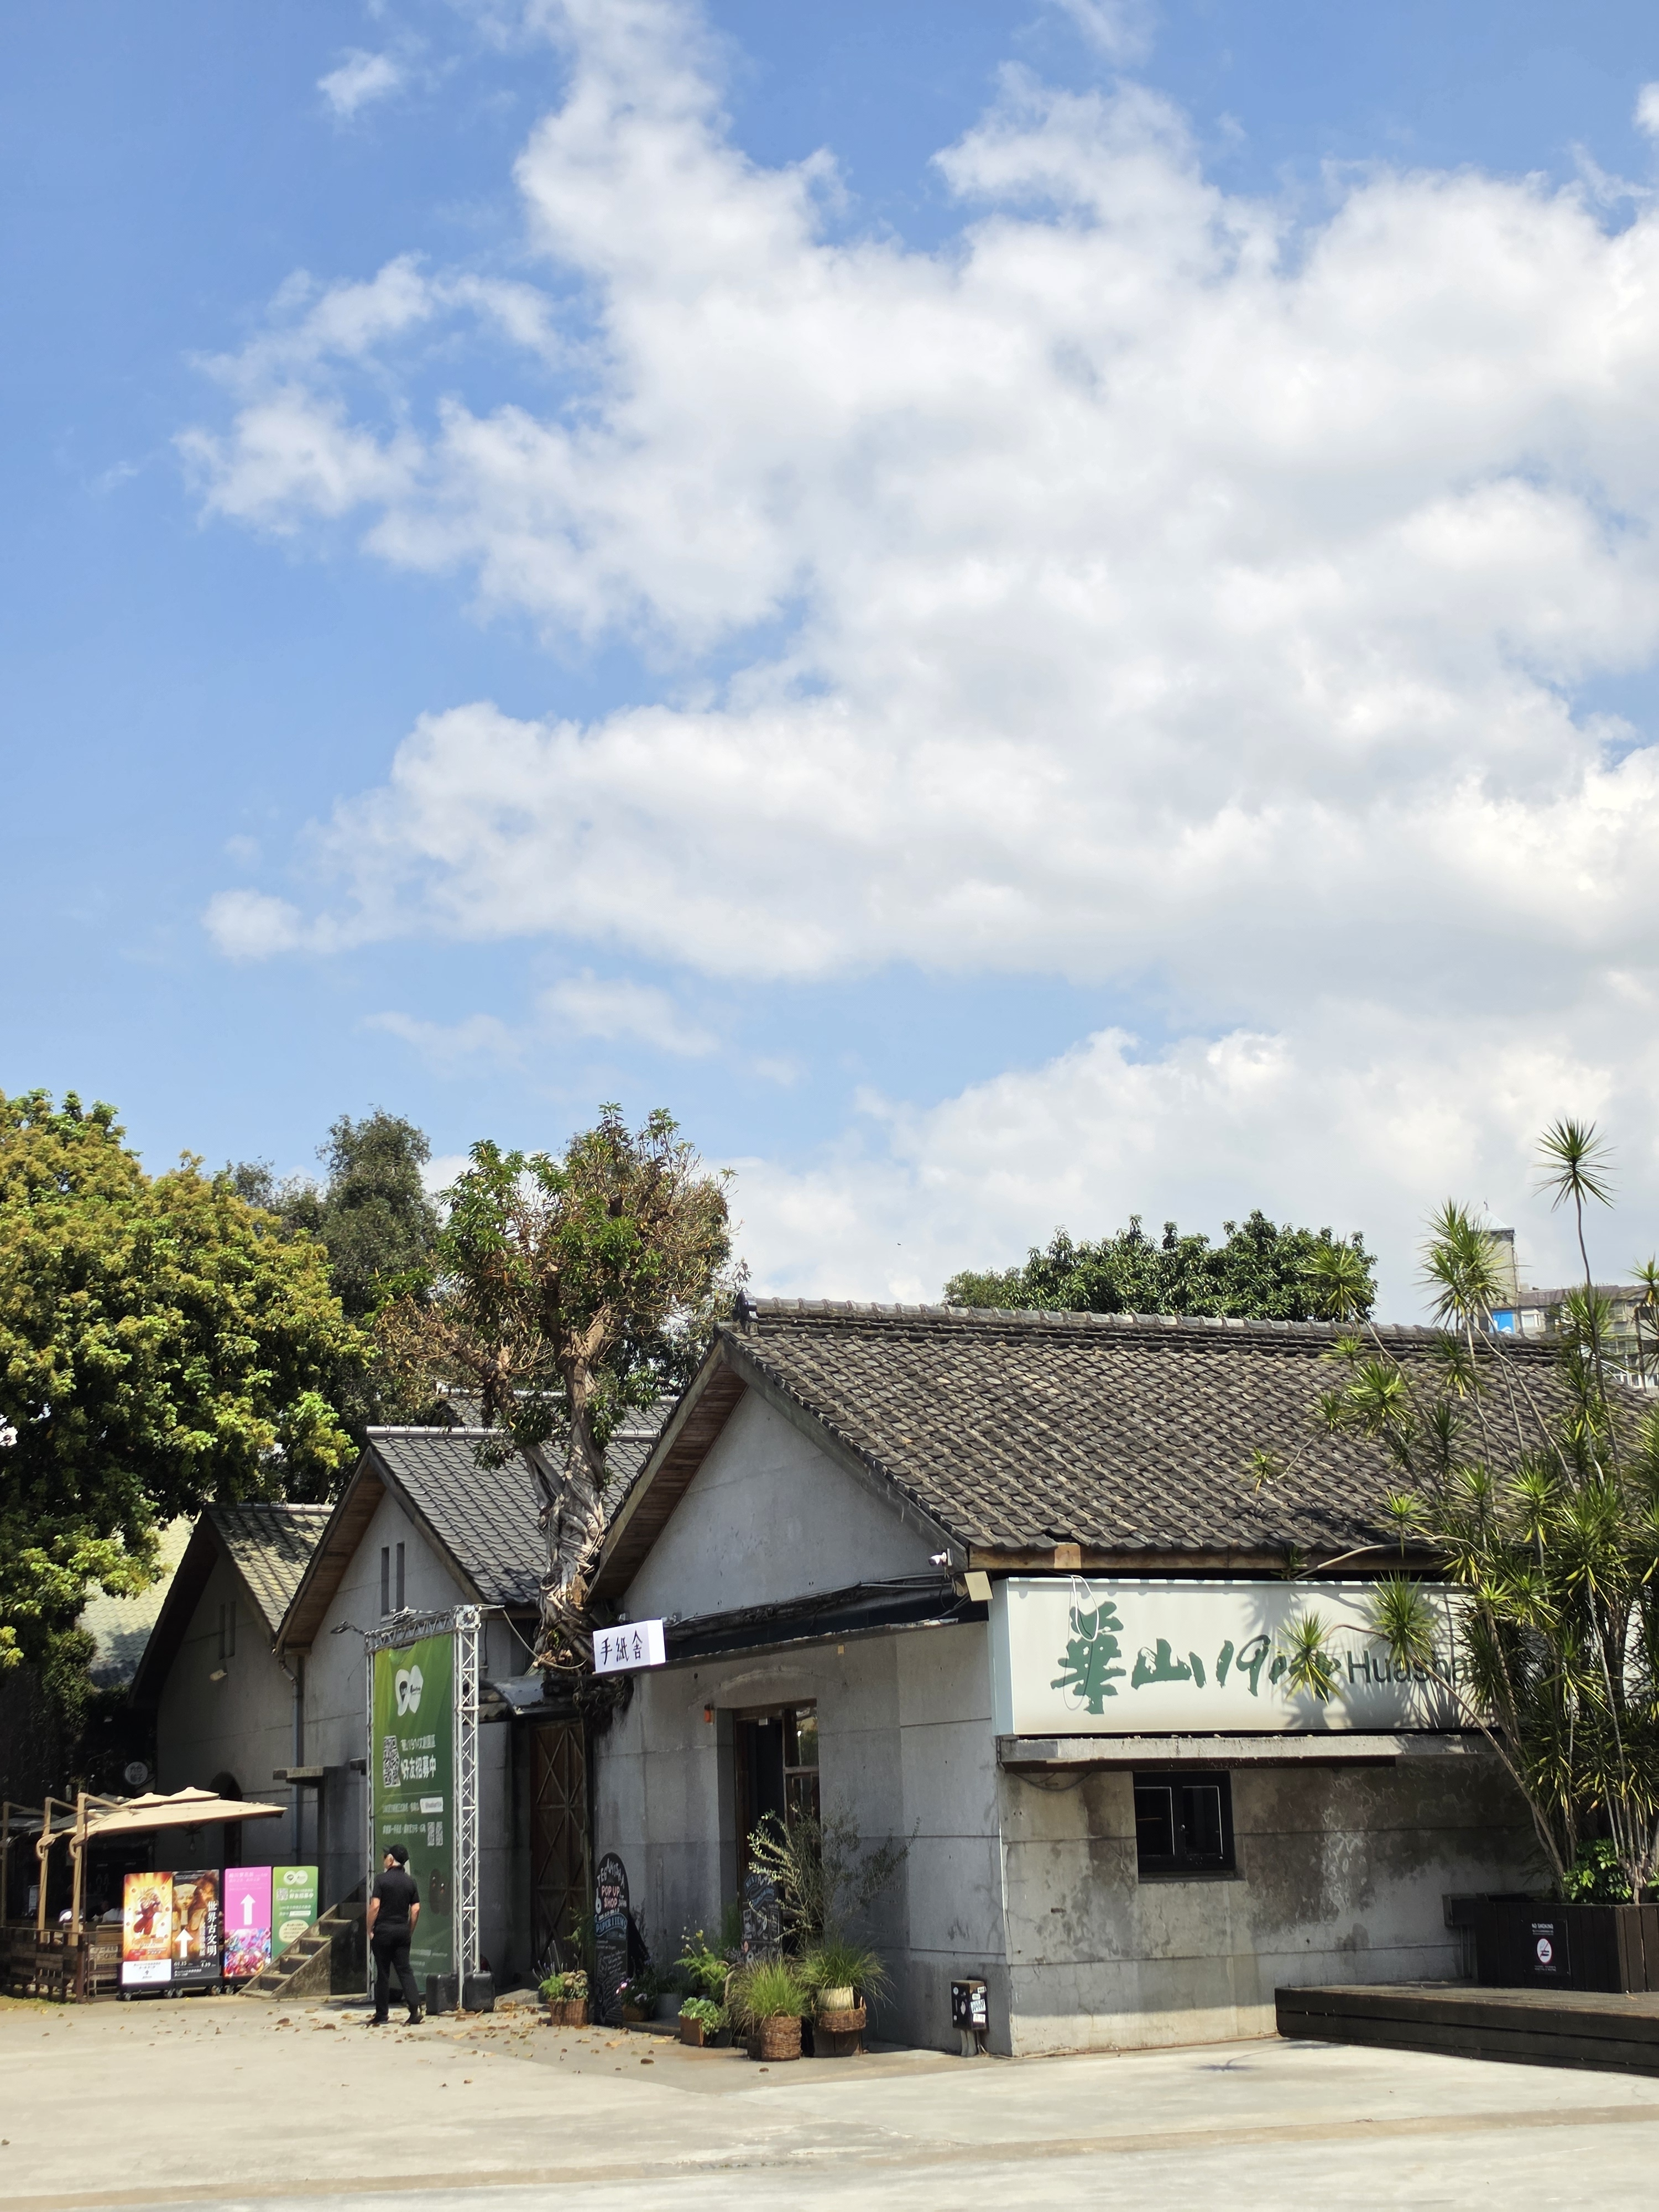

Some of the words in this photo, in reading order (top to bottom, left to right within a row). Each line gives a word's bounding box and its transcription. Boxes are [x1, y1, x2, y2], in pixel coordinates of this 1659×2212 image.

[1347, 1650, 1471, 1684] Huasha
[400, 1754, 436, 1781] 好友招募中
[601, 1885, 612, 1897] POP
[612, 1885, 620, 1897] UP
[604, 1897, 618, 1908] SHOP
[206, 1901, 217, 1956] 世界古文明
[596, 1917, 611, 1933] PAPER
